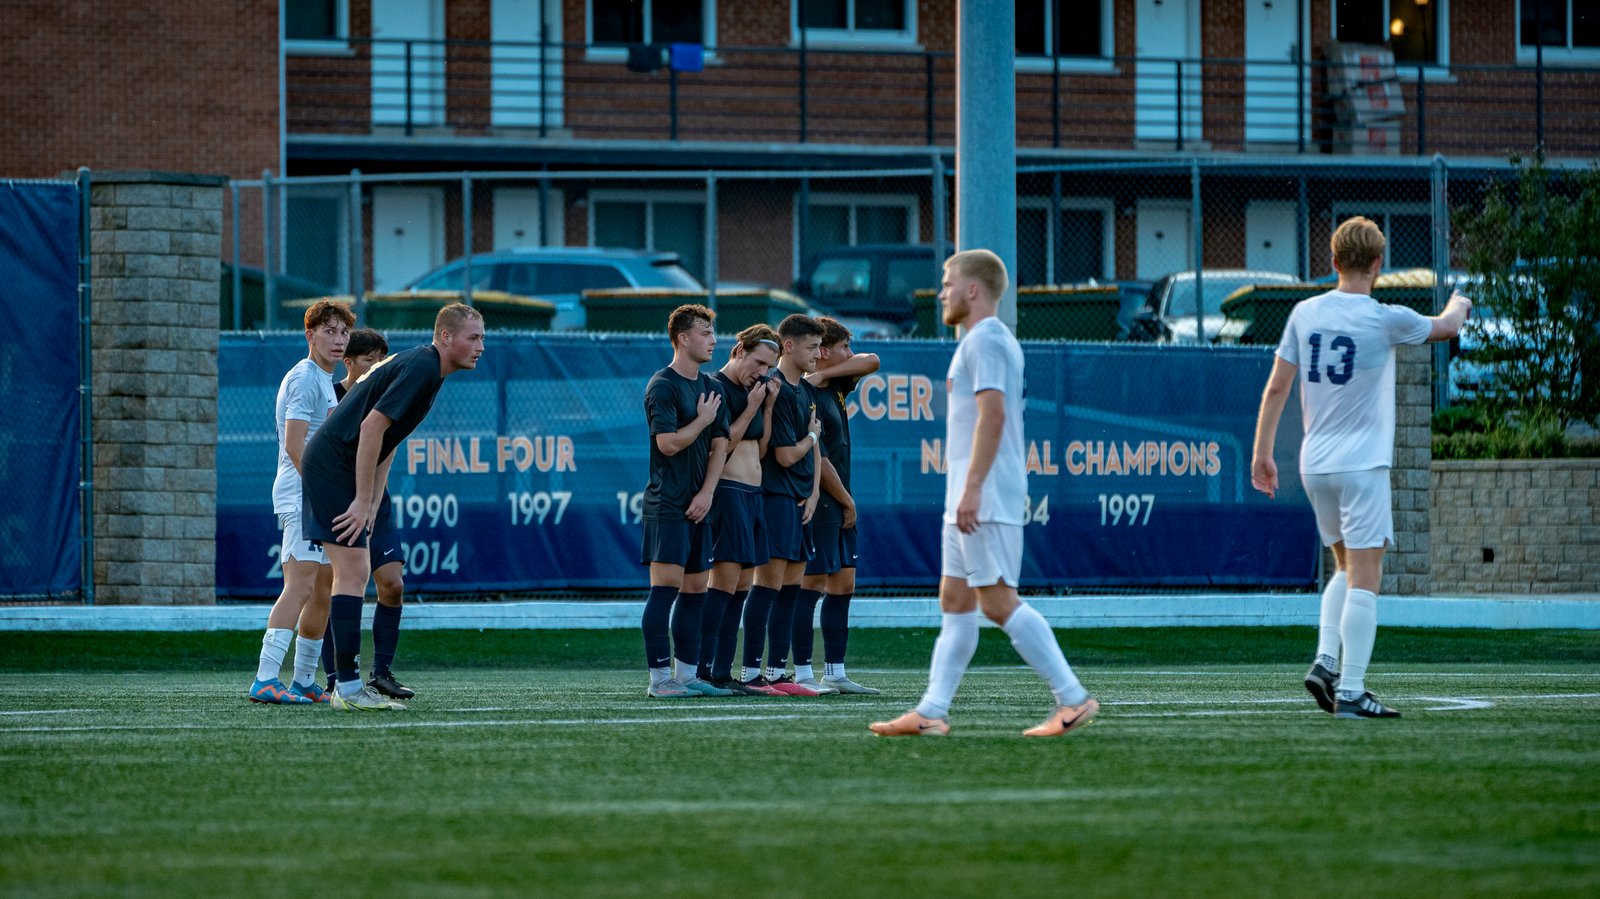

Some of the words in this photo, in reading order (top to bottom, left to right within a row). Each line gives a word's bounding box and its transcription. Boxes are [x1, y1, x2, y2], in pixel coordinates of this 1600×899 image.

[1307, 332, 1357, 385] 13
[407, 438, 490, 475] FINAL
[497, 435, 577, 473] FOUR
[1065, 440, 1222, 476] CHAMPIONS
[391, 493, 459, 529] 1990
[508, 491, 573, 526] 1997
[1098, 494, 1156, 527] 1997
